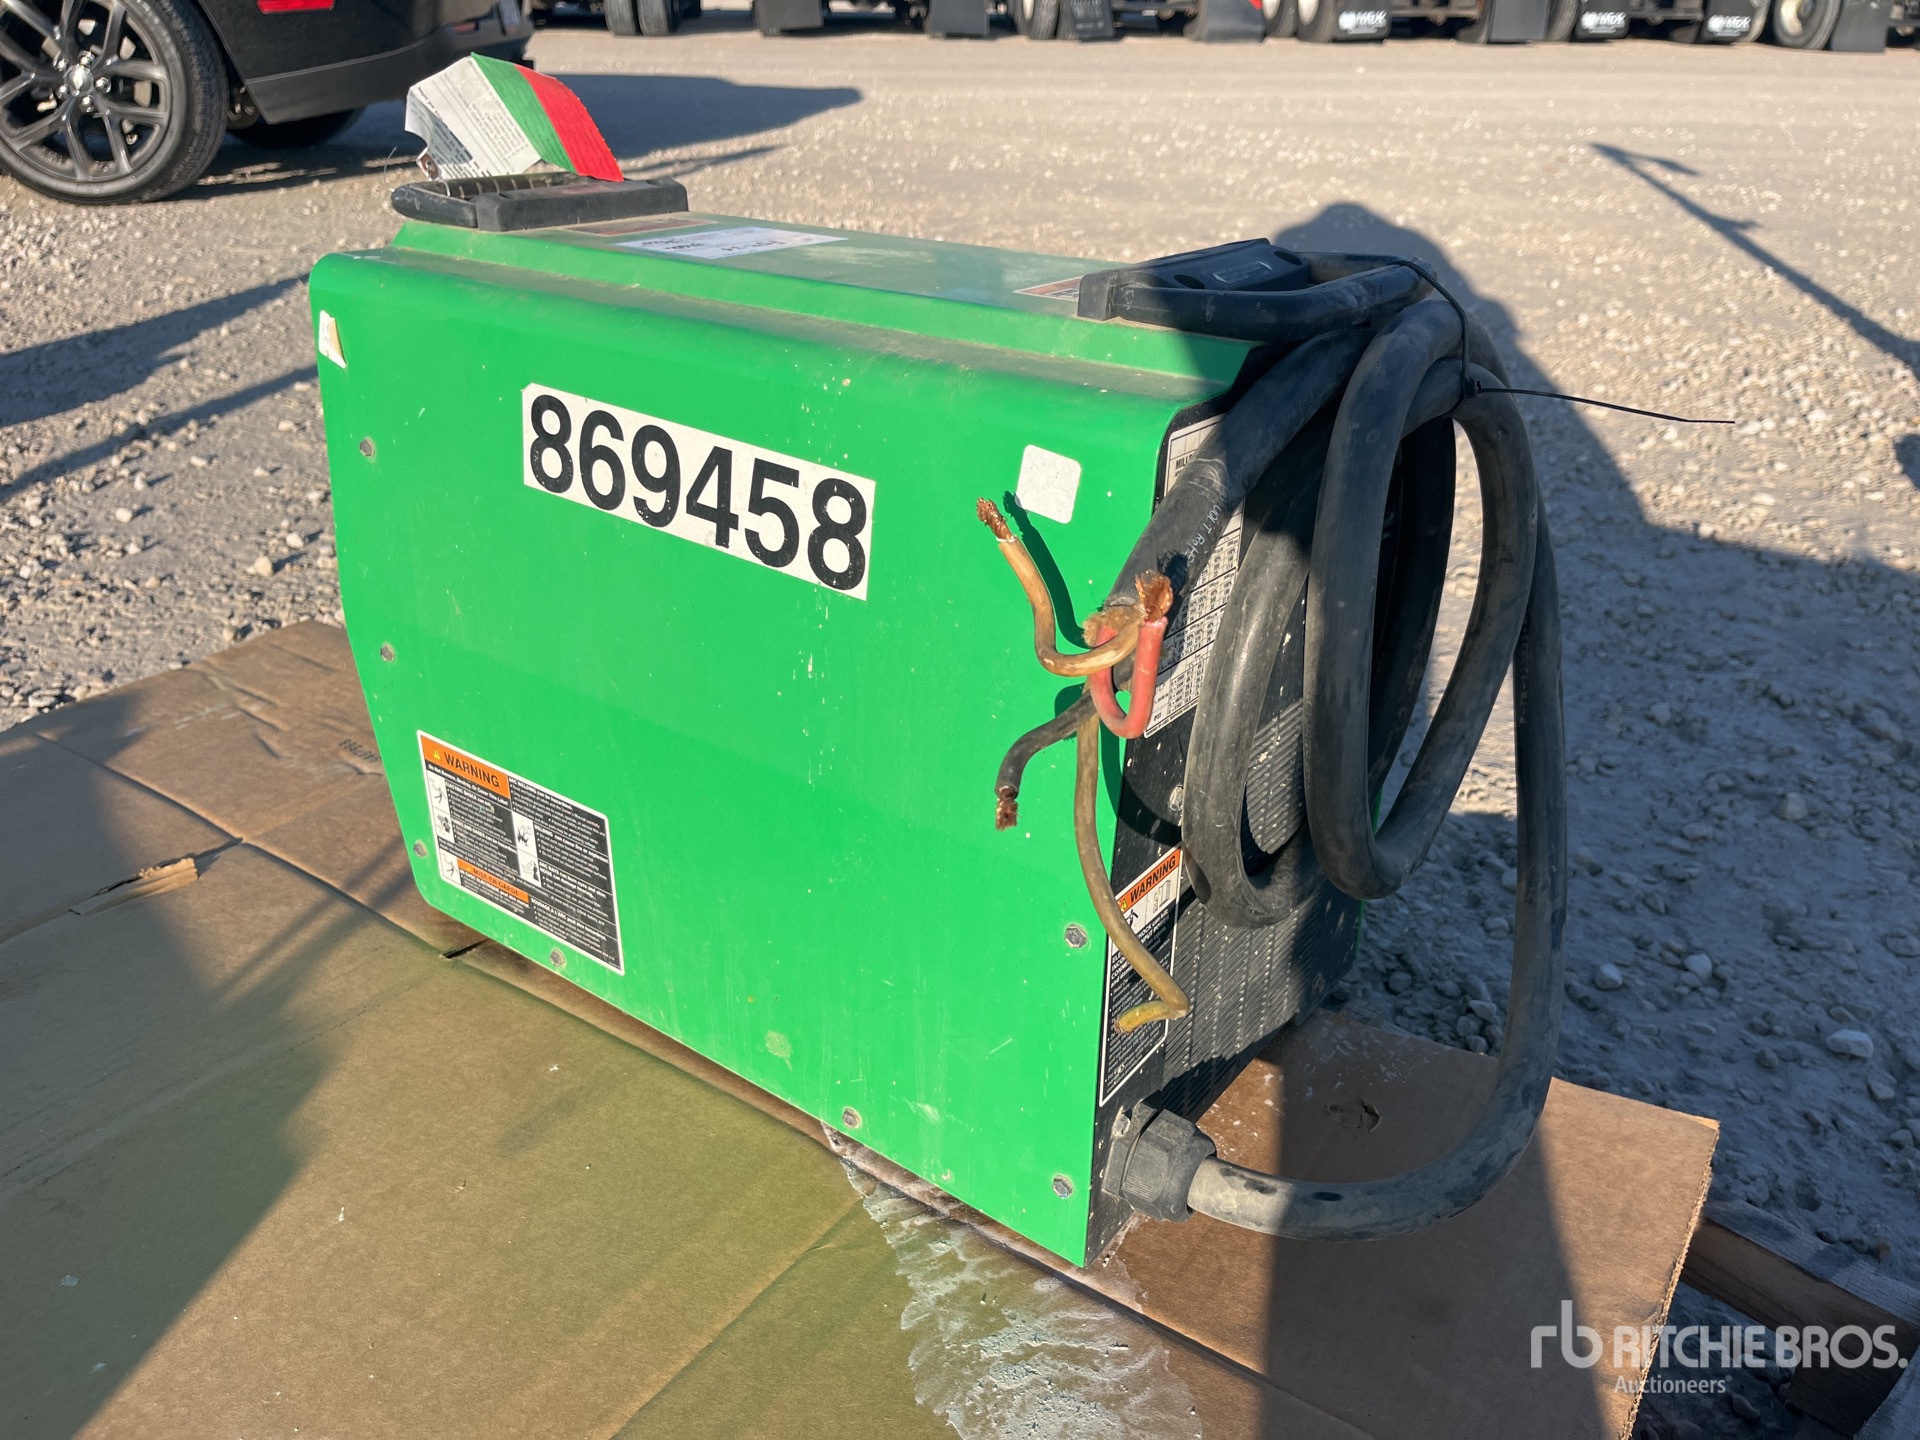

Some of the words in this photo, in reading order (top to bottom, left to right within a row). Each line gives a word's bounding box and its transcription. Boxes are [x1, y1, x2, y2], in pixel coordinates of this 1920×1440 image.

[530, 394, 867, 591] 869458
[444, 751, 499, 788] WARNING
[1130, 855, 1177, 904] WARNING
[1138, 922, 1151, 940] HOCK
